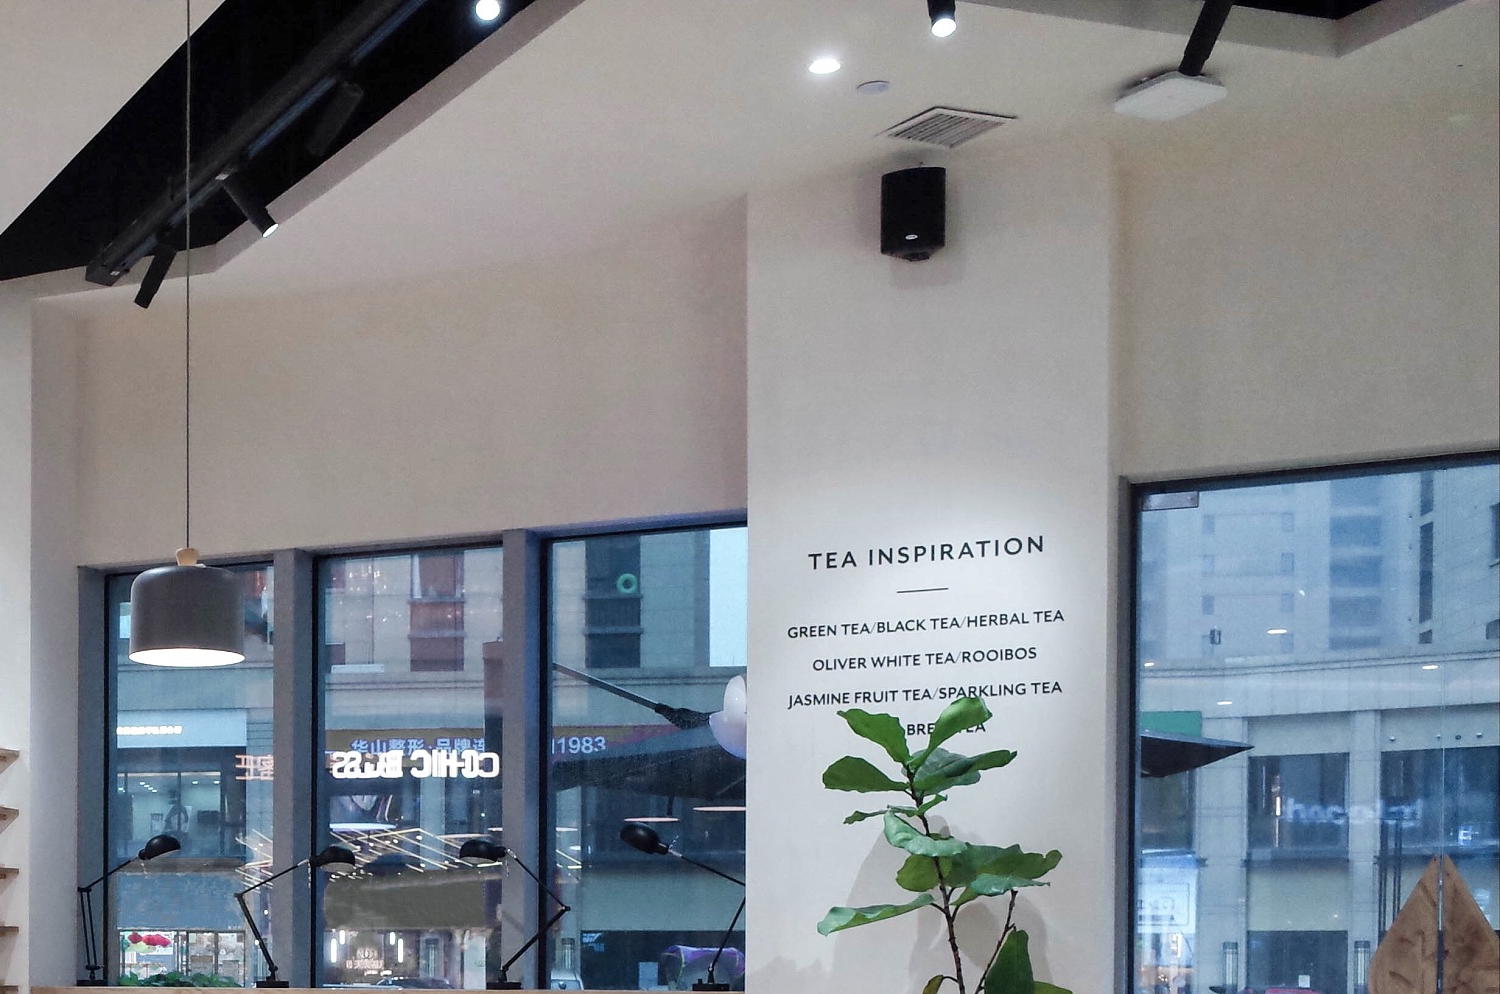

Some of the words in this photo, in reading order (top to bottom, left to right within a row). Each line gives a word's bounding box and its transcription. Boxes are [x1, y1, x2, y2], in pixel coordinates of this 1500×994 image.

[808, 550, 858, 570] TEA
[868, 535, 1045, 566] INSPIRATION
[787, 624, 838, 639] GREEN
[1033, 609, 1065, 623] TEA
[812, 657, 868, 671] OLIVER
[871, 654, 921, 668] WHITE
[787, 692, 851, 710] JASMINE
[854, 690, 899, 704] FRUIT
[1031, 681, 1063, 695] TEA
[906, 722, 937, 736] BRE
